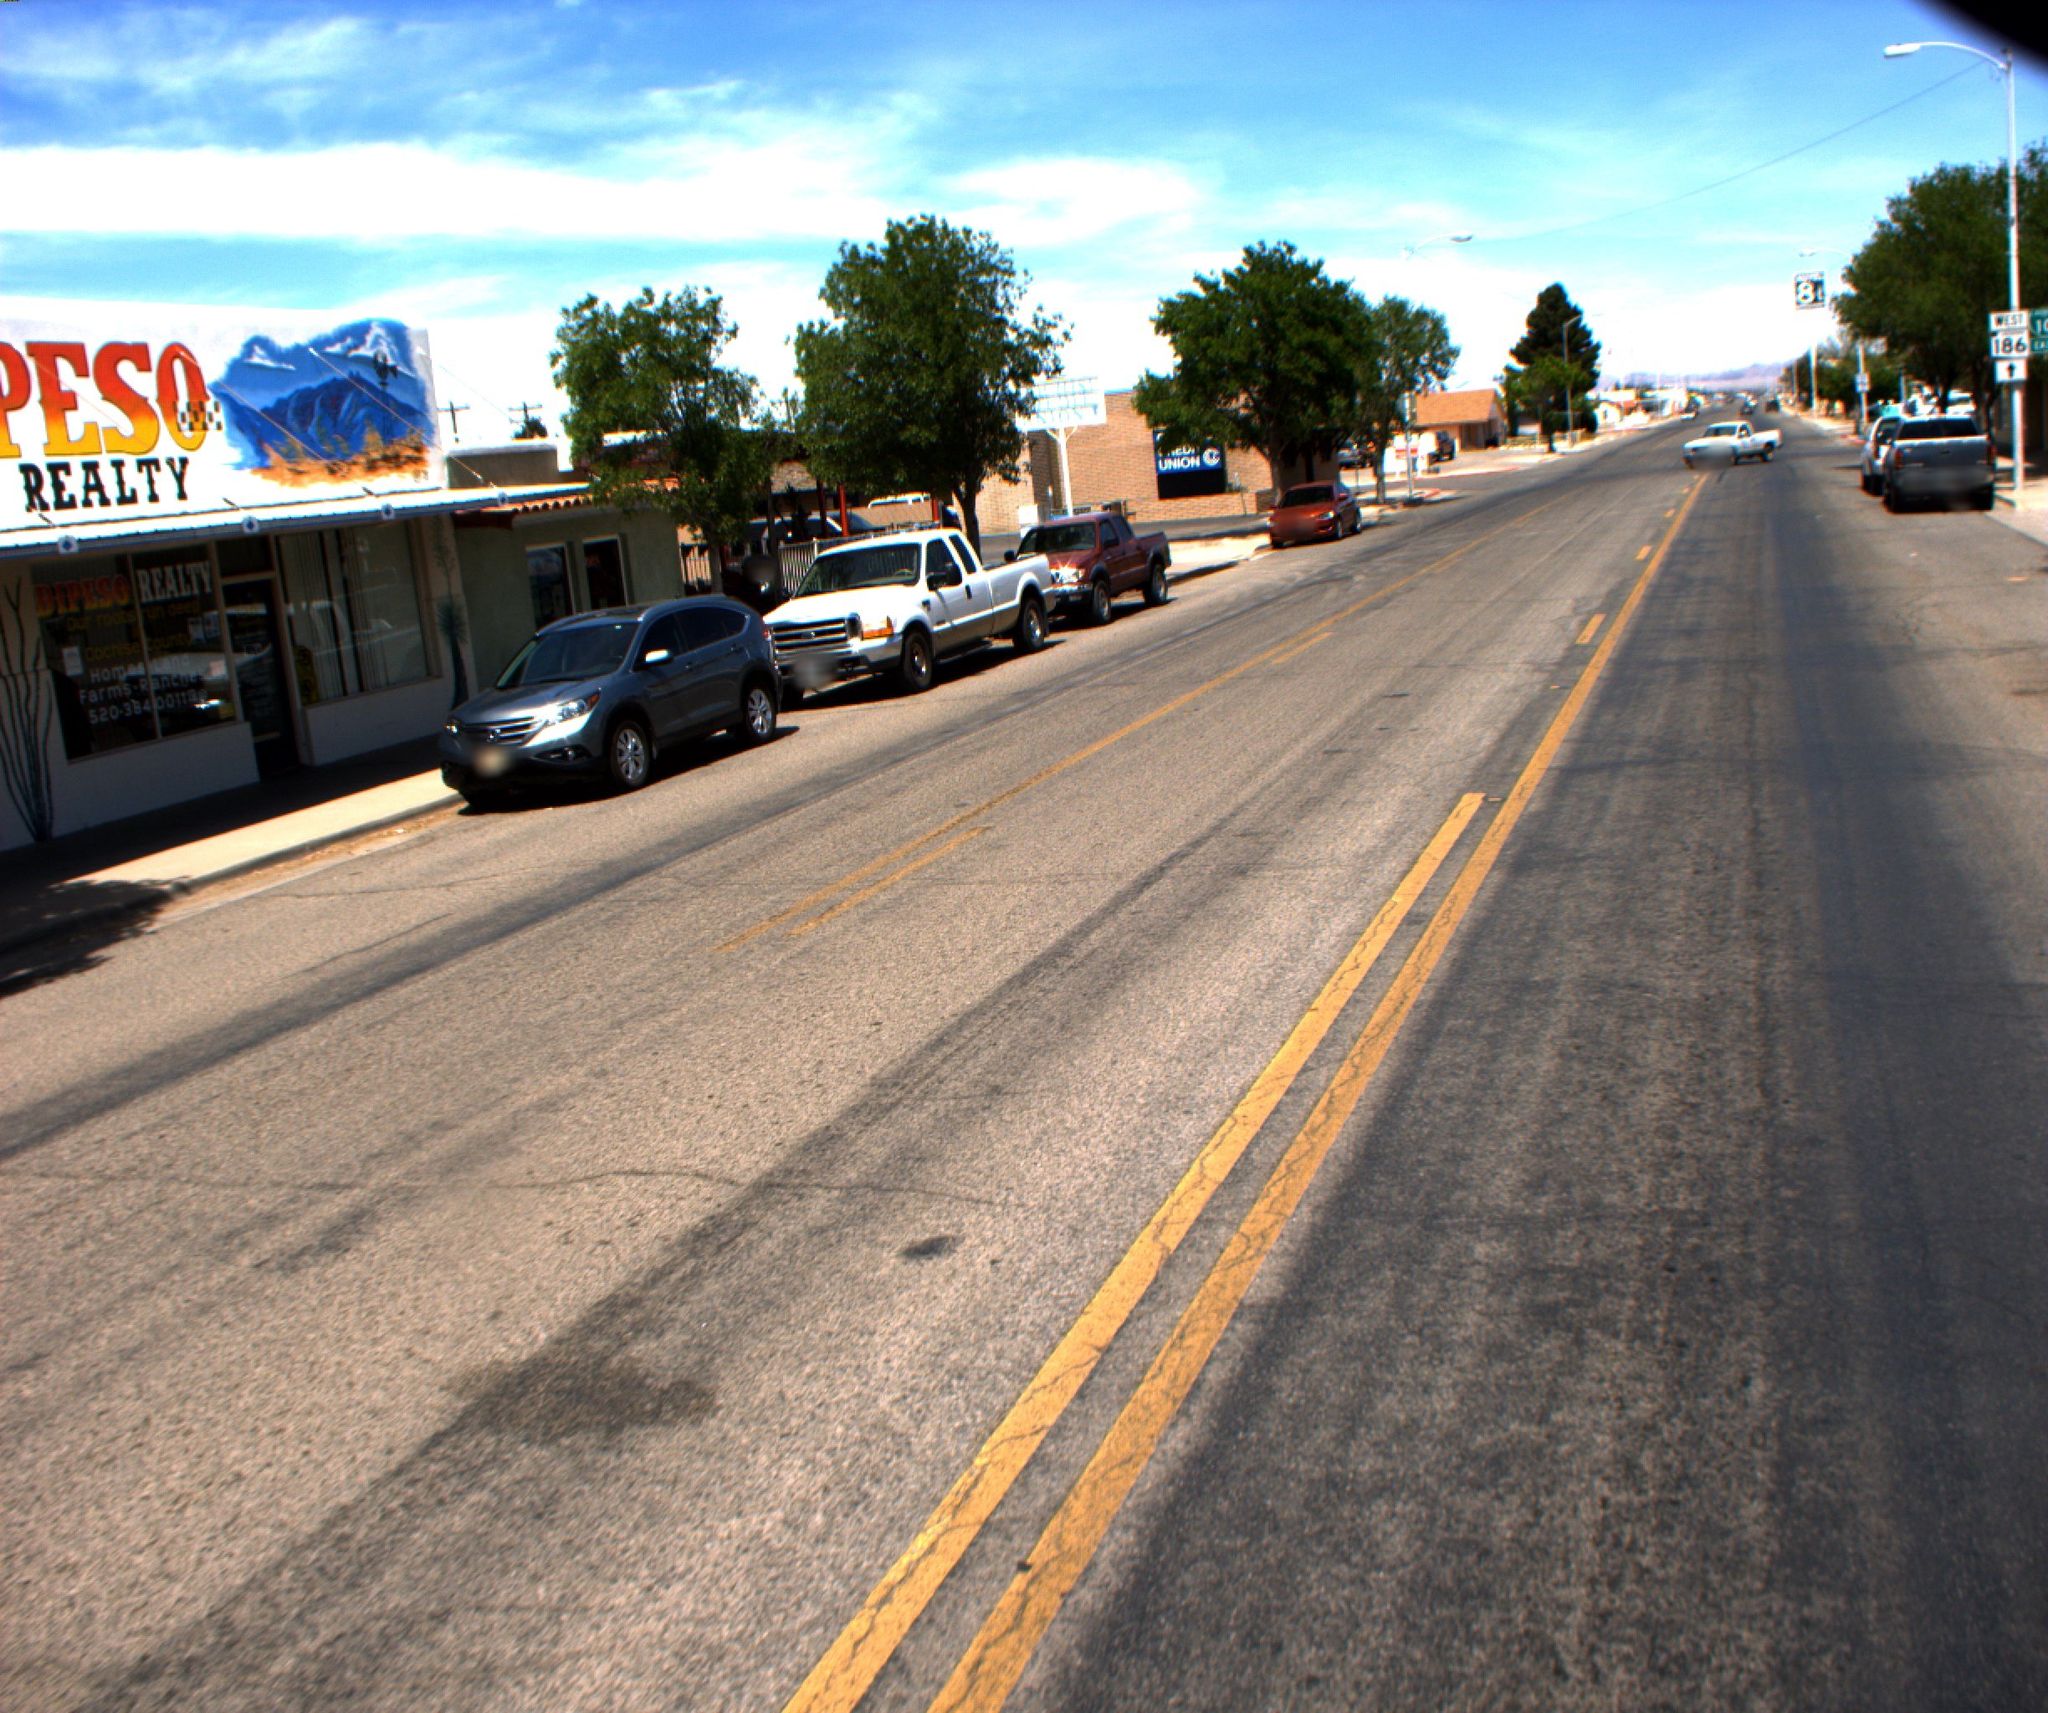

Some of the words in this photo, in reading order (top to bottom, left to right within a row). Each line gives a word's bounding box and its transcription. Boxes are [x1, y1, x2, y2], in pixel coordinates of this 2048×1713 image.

[1994, 313, 2024, 327] WEST
[1993, 337, 2027, 354] 186
[0, 342, 208, 458] PESO
[1158, 455, 1200, 471] UNION
[19, 456, 189, 512] REALTY
[136, 561, 213, 603] REALTY
